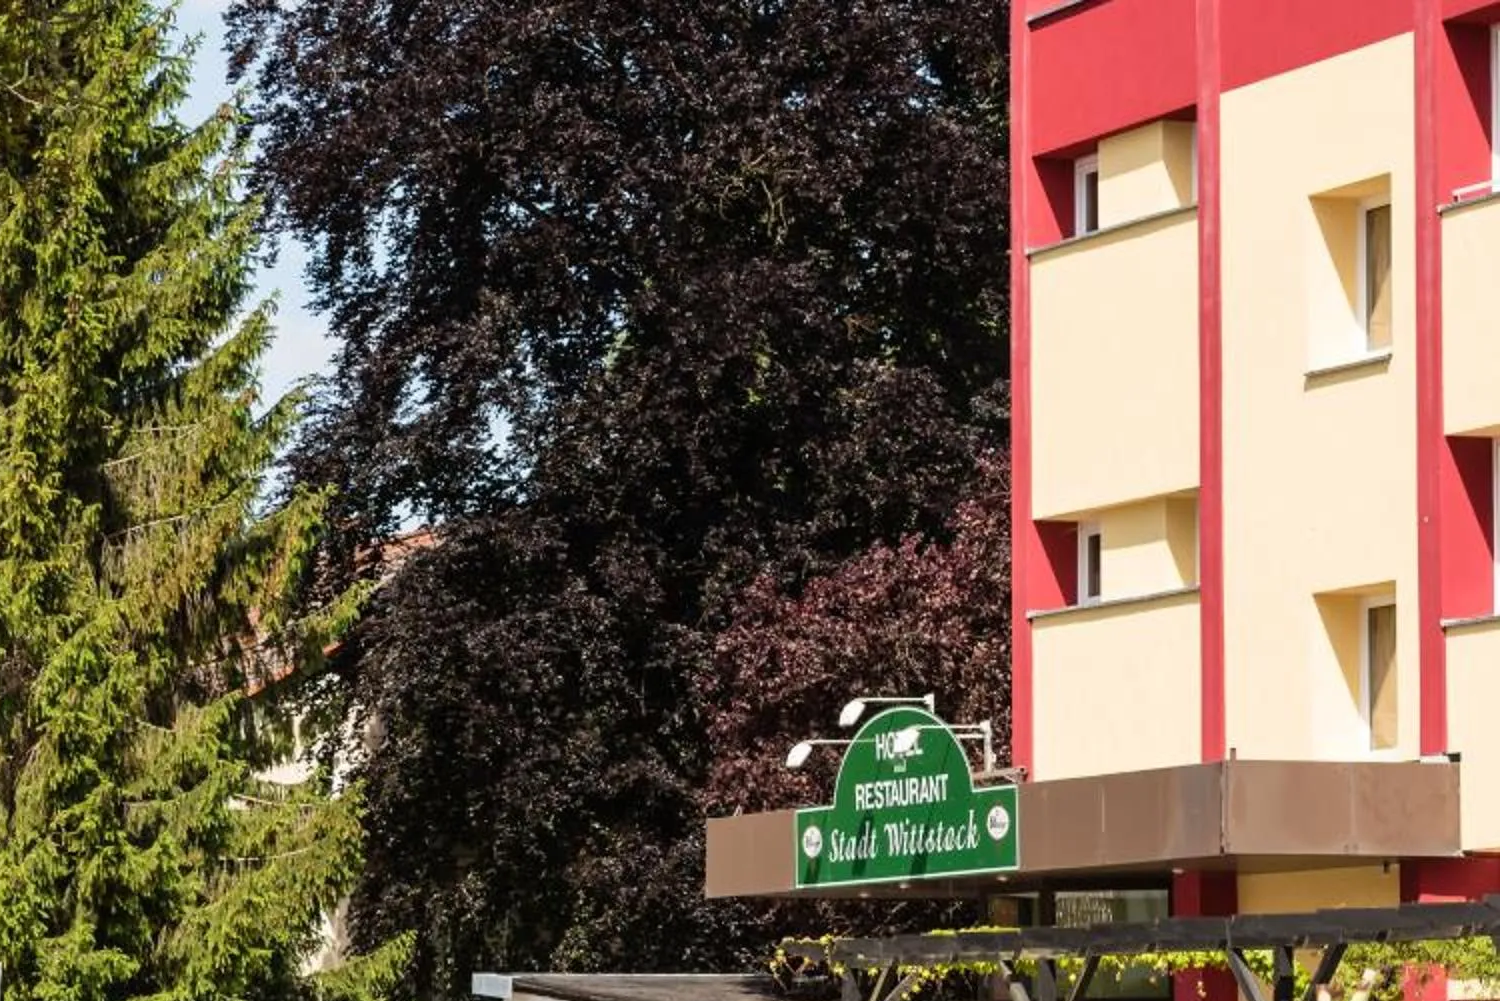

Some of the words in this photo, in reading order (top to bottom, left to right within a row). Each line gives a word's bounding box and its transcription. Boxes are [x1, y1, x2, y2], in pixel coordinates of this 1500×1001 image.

[875, 732, 923, 760] HOL
[855, 774, 949, 811] RESTAURANT
[829, 821, 878, 863] Stadt
[884, 809, 980, 857] Wittstock
